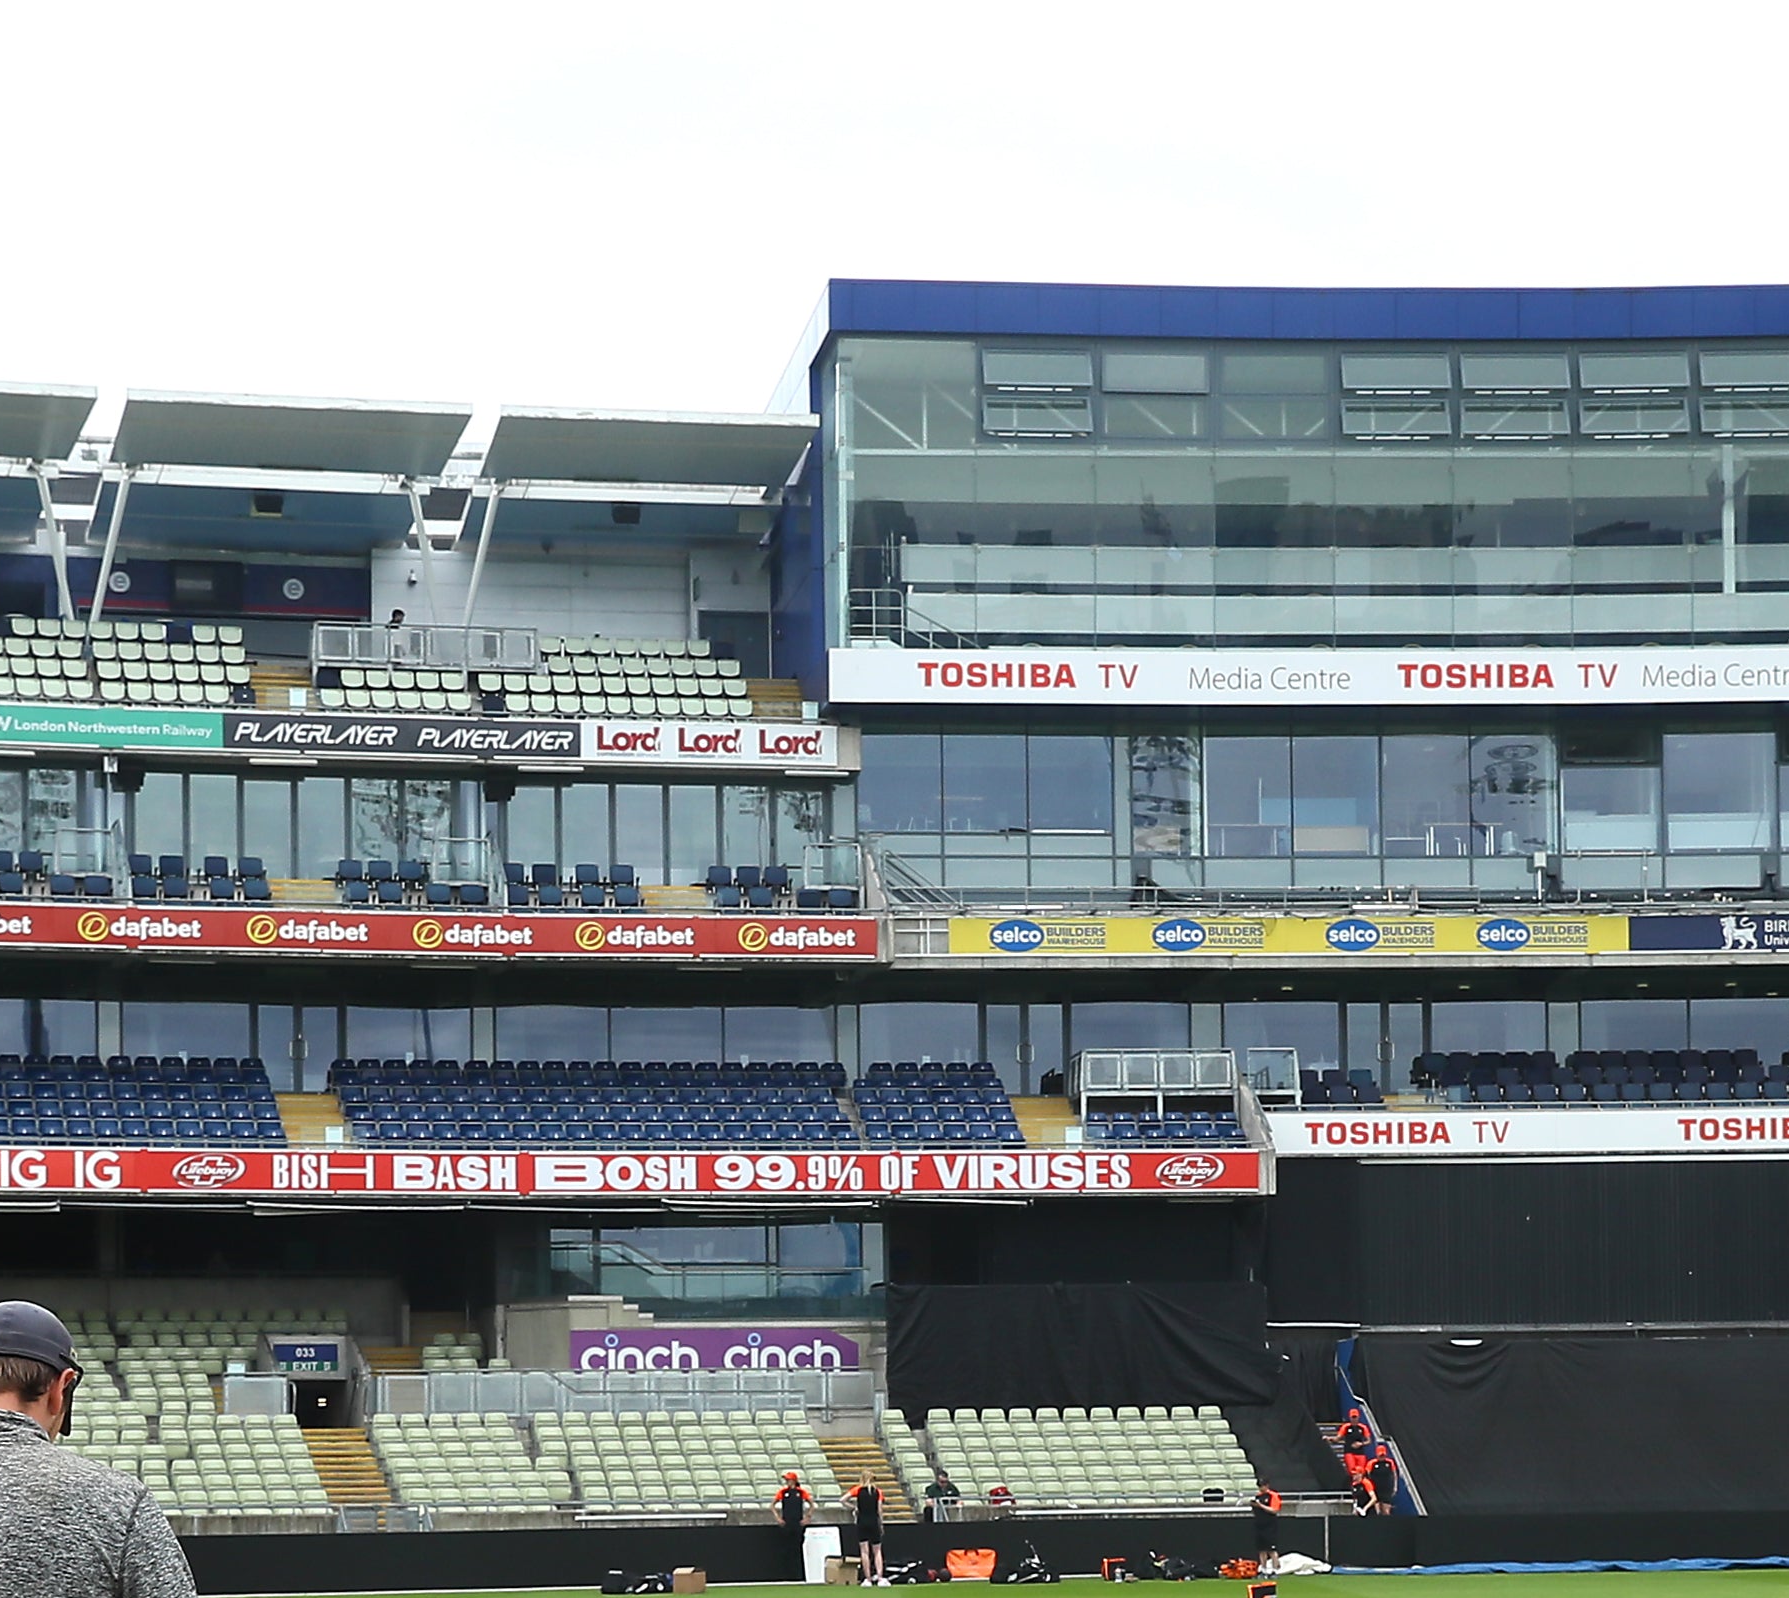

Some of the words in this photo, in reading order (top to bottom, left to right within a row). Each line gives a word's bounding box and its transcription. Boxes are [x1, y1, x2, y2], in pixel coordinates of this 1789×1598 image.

[918, 661, 1077, 689] TOSHIBA
[1099, 664, 1139, 689] TV
[1189, 666, 1261, 690] Media
[1270, 667, 1351, 691] Centre
[1398, 663, 1554, 689] TOSHIBA
[1578, 664, 1618, 689] TV
[1642, 664, 1716, 689] Media
[14, 718, 66, 733] London
[67, 720, 160, 736] Northwestern
[162, 723, 213, 740] Railway
[233, 721, 399, 746] PLAYERLAYER
[417, 727, 575, 751] PLAYERLAYER
[596, 725, 660, 751] Lord
[678, 727, 741, 753] Lord
[759, 729, 822, 755] Lord
[111, 915, 202, 940] dafabet
[278, 919, 368, 943] dafabet
[446, 922, 533, 947] dafabet
[606, 923, 695, 948] dafabet
[769, 926, 856, 949] dafabet
[992, 925, 1042, 943] selco
[1155, 925, 1204, 943] selco
[1328, 925, 1378, 944] selco
[1479, 925, 1529, 943] selco
[1532, 924, 1588, 935] BUILDERS
[1533, 936, 1588, 945] WAREHOUSE
[1305, 1121, 1451, 1145] TOSHIBA
[1473, 1121, 1510, 1143] TV
[0, 1149, 47, 1188] IG
[74, 1150, 122, 1189] IG
[180, 1165, 237, 1177] Lifebuoy
[272, 1154, 375, 1189] BISH
[393, 1155, 517, 1190] BASH
[534, 1156, 697, 1191] BOSH
[713, 1155, 863, 1191] 99.9%
[880, 1156, 919, 1191] OF
[933, 1155, 1131, 1190] VIRUSES
[1162, 1162, 1217, 1178] Lifebuoy
[295, 1347, 316, 1358] 033
[580, 1333, 699, 1372] cinch
[724, 1331, 841, 1371] cinch
[292, 1361, 318, 1371] EXIT
